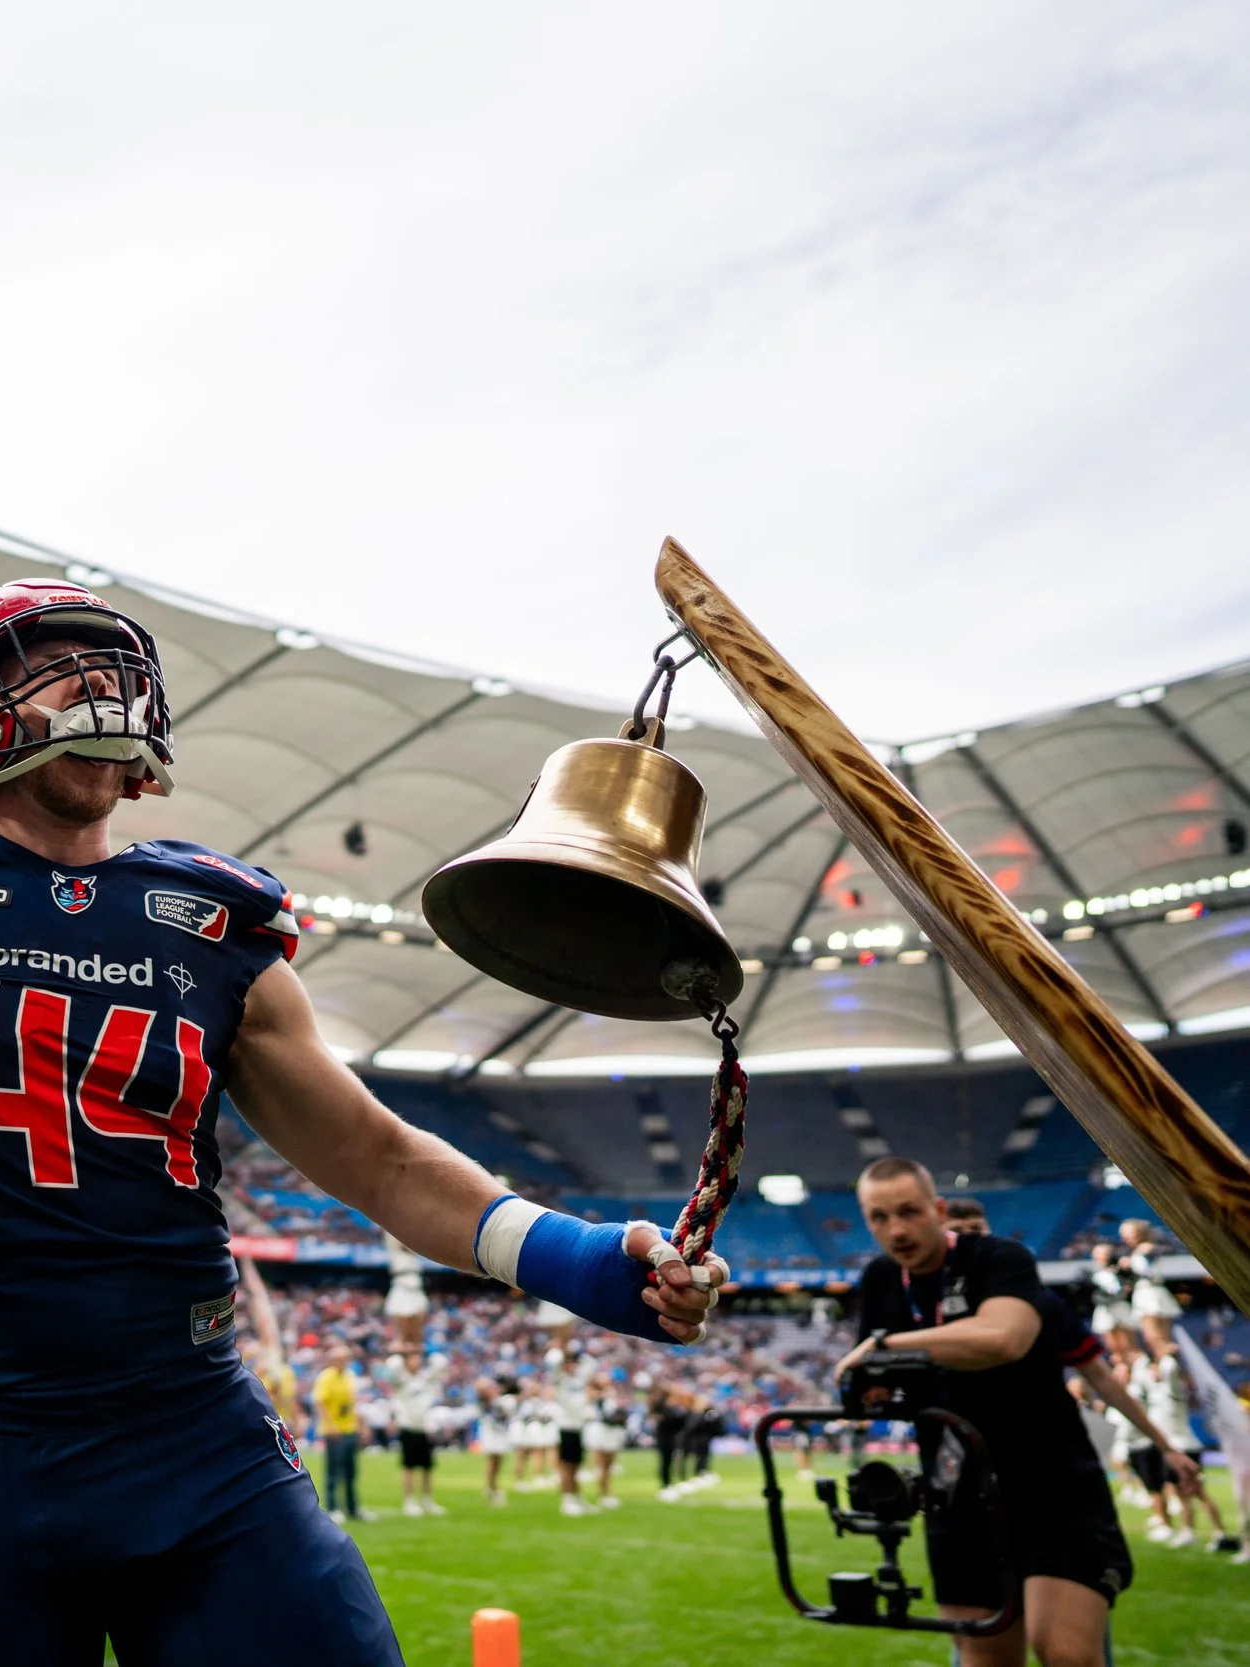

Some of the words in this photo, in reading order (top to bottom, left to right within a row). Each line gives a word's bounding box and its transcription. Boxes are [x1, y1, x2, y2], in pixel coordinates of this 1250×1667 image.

[155, 896, 196, 910] EUROPEAN
[155, 902, 184, 914] LEAGUE
[156, 909, 192, 925] FOOTBALL
